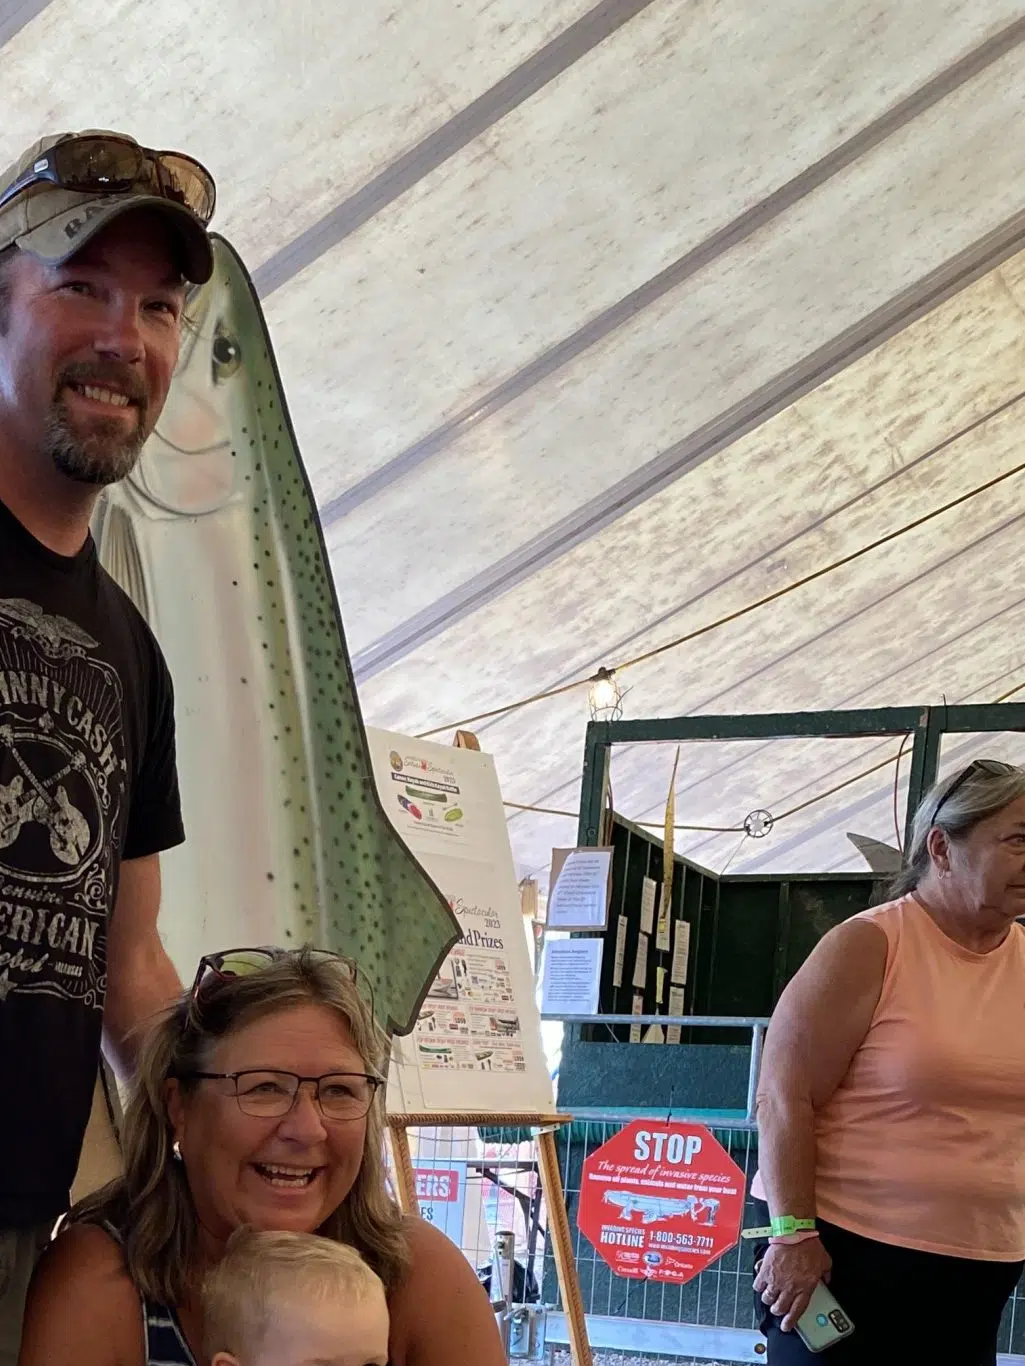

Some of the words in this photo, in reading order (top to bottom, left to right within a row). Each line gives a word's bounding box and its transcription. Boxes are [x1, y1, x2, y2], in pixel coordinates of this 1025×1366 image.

[68, 696, 118, 776] CASH
[473, 930, 503, 949] Prizes
[634, 1131, 702, 1165] STOP
[598, 1160, 614, 1171] The
[616, 1163, 648, 1177] spread
[649, 1165, 661, 1179] of
[660, 1169, 697, 1180] invasive
[698, 1171, 731, 1185] species
[600, 1231, 644, 1248] HOTLINE
[650, 1231, 714, 1248] 1-800-563-7711
